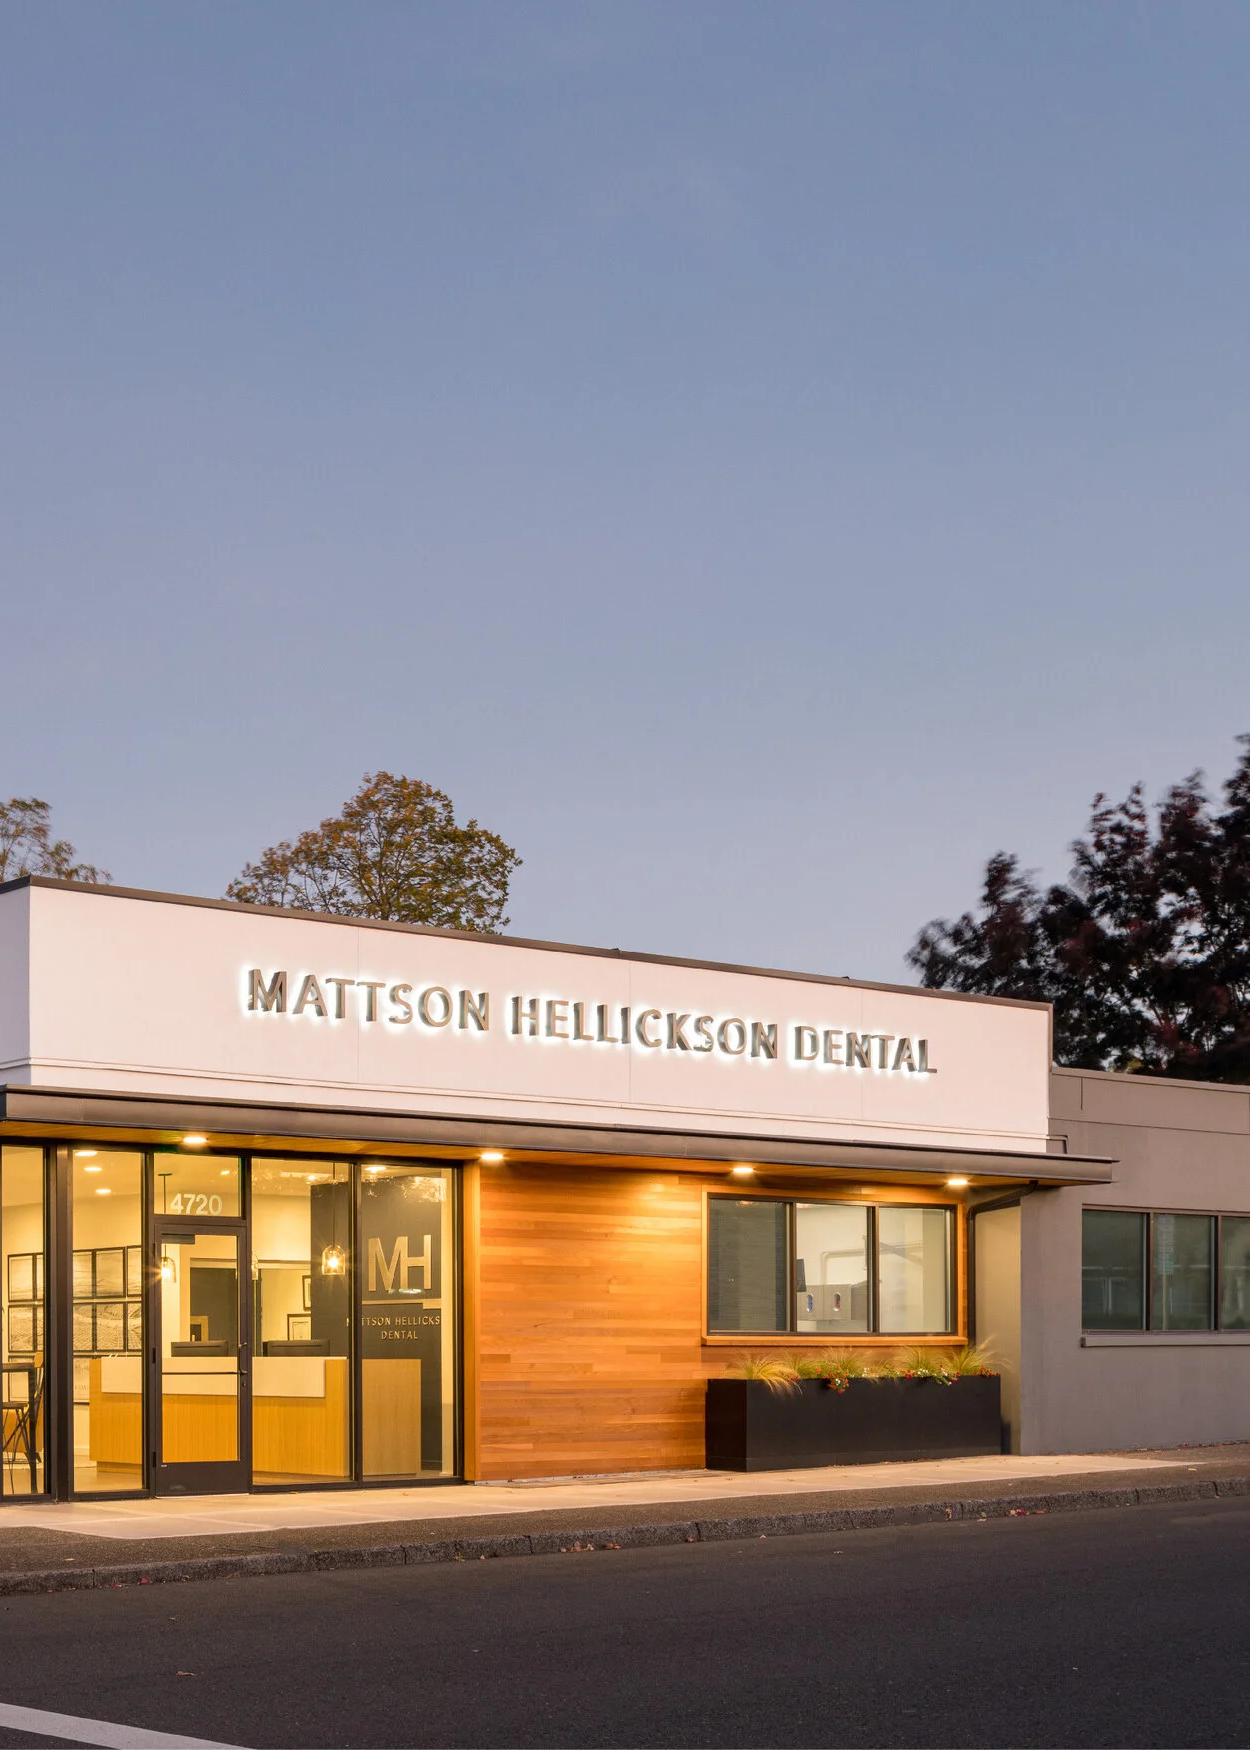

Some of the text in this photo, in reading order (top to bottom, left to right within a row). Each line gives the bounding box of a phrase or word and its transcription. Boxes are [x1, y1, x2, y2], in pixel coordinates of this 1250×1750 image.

[248, 968, 938, 1074] MATTSON HELLICKSON DENTAL
[170, 1193, 223, 1216] 4720
[368, 1234, 432, 1292] MH
[345, 1315, 440, 1327] TTSON HELLICKS
[381, 1330, 418, 1340] DENTAL
